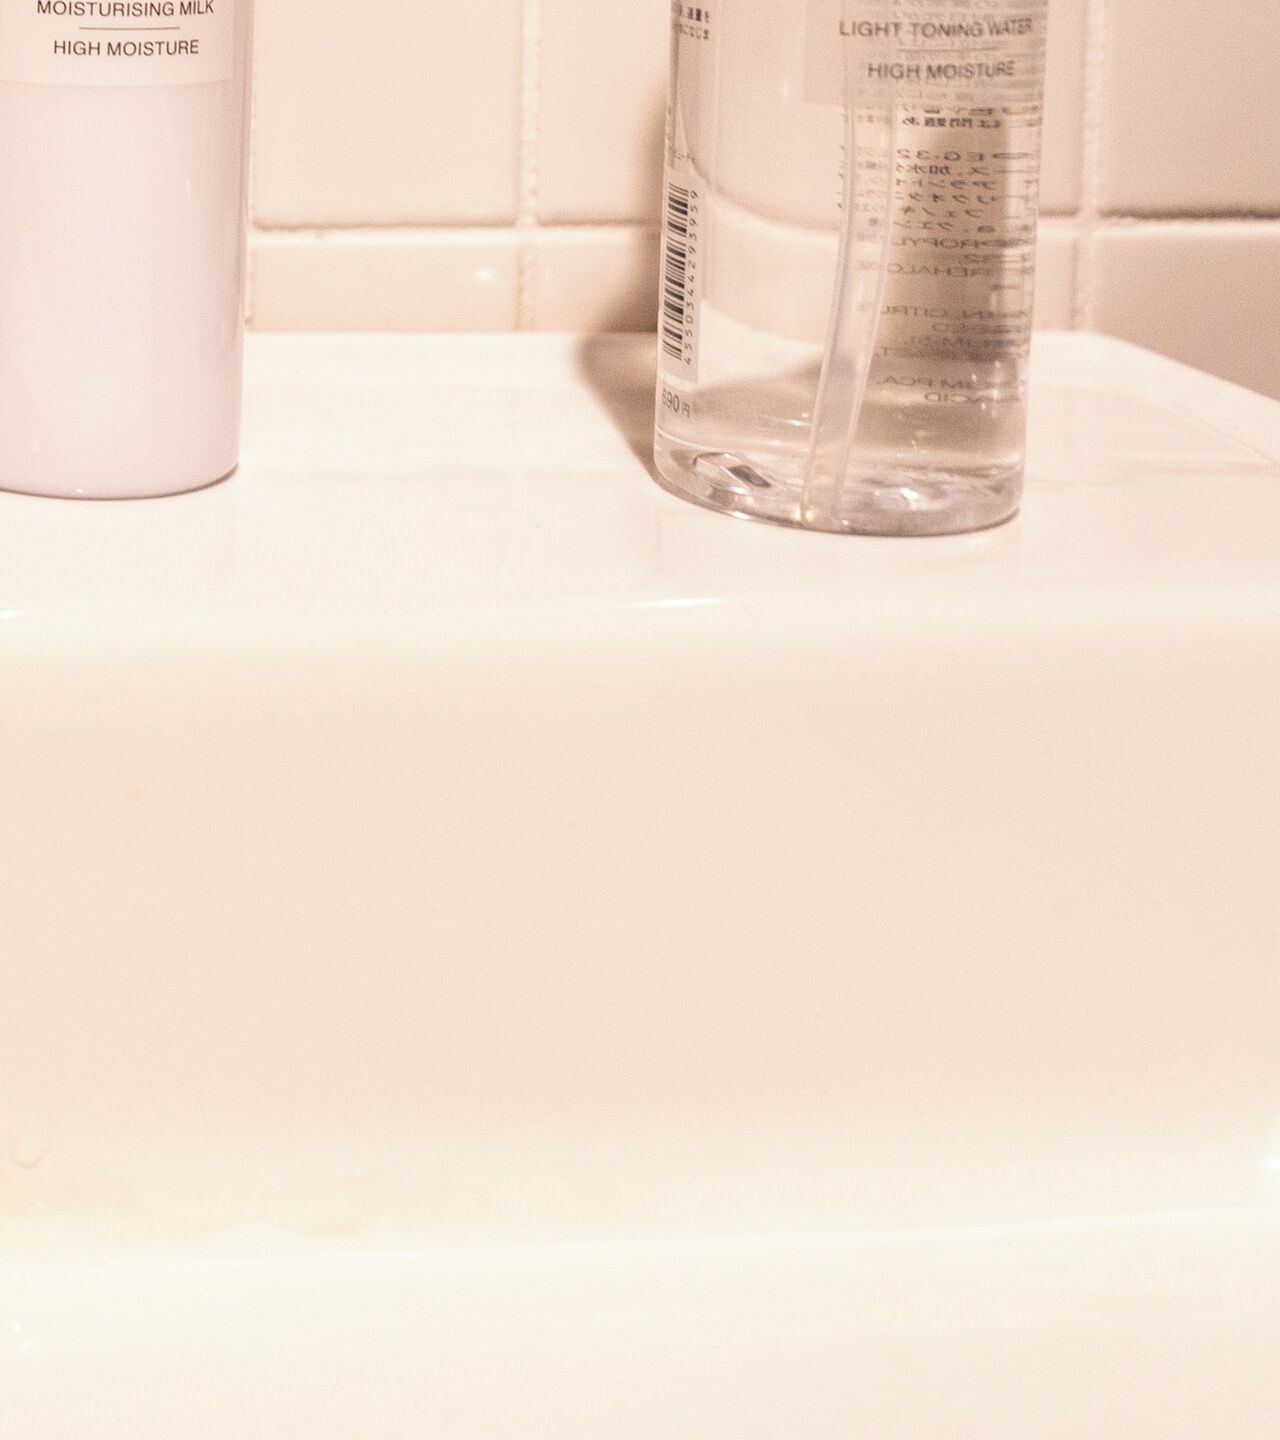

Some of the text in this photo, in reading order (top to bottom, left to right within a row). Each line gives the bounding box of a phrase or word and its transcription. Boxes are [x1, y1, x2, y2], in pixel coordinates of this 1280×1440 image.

[37, 0, 215, 17] MOISTURISING MILK
[840, 17, 1033, 38] LIGHT TONING WATER
[53, 39, 199, 56] HIGH MOISTURE
[869, 60, 1016, 79] HIGH MOISTURE
